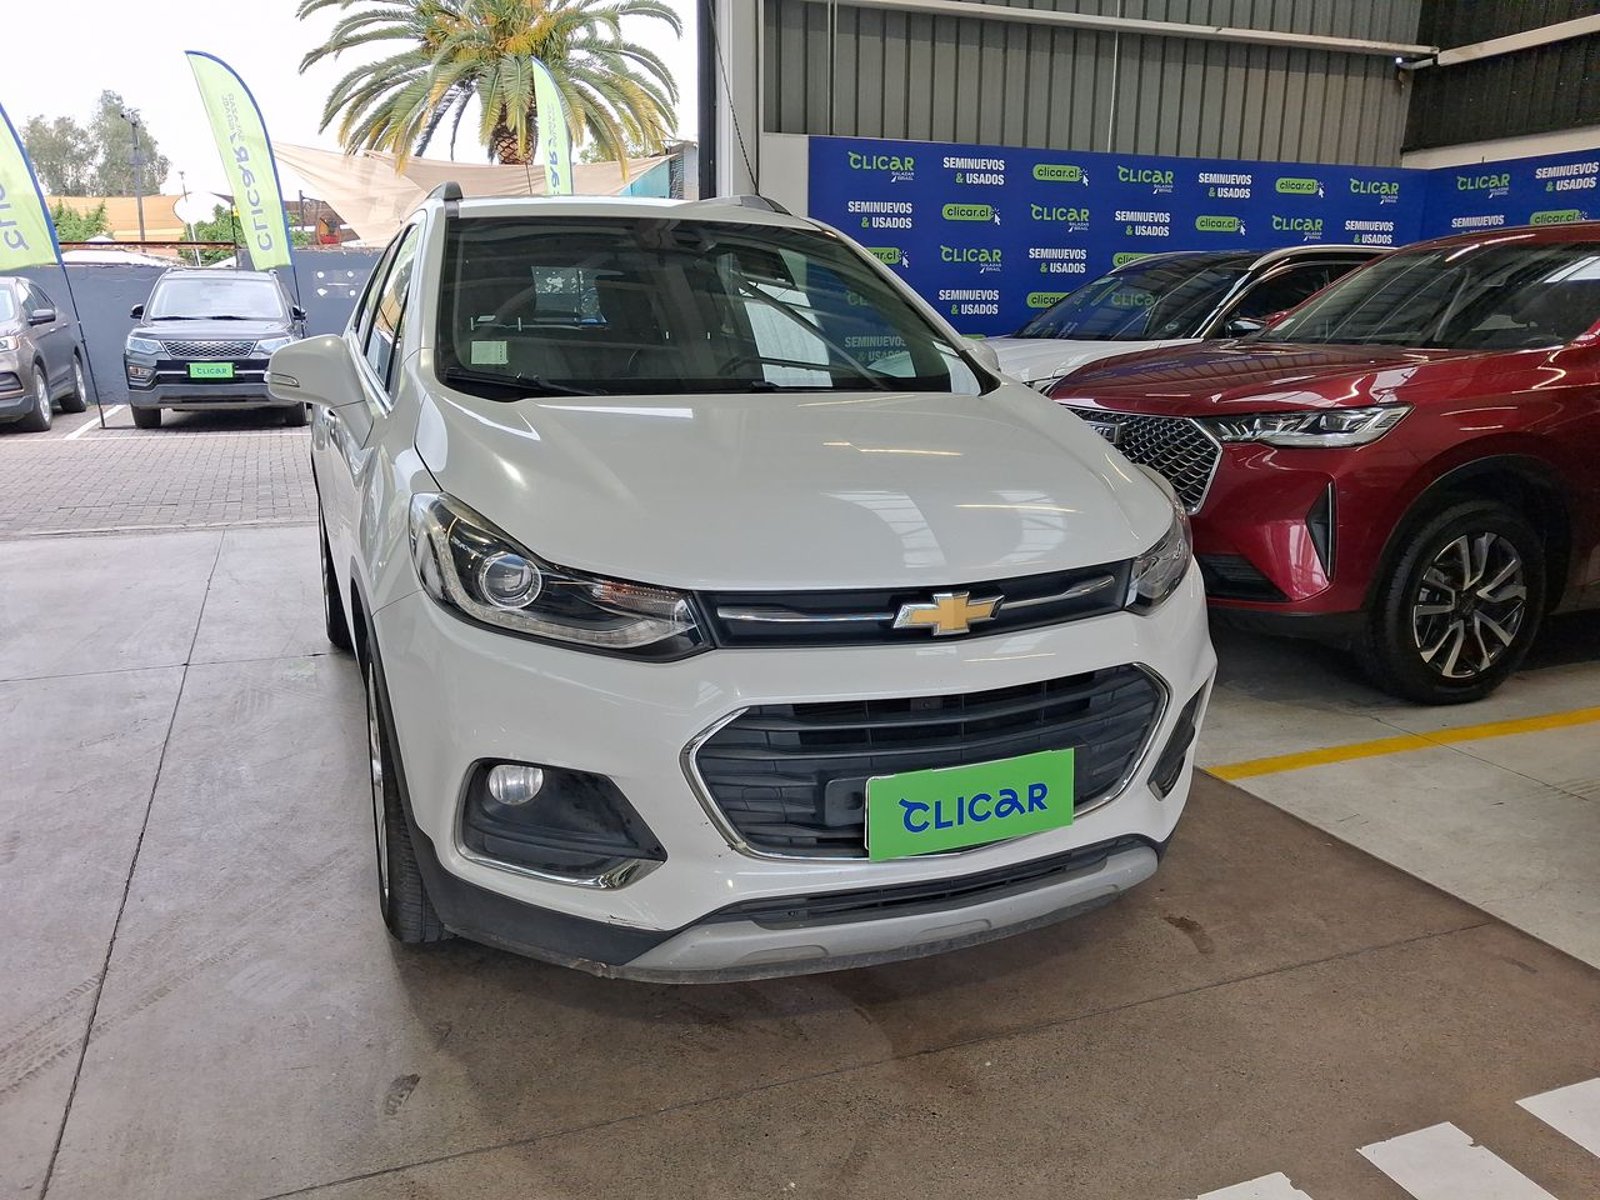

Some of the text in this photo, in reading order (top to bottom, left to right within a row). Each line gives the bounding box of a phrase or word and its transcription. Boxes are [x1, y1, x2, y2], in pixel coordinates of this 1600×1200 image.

[943, 157, 1005, 170] SEMINUEVOS
[1037, 167, 1077, 179] clicar.cl
[1535, 161, 1600, 179] SEMINUEVOS
[956, 172, 1005, 185] & USADOS
[1199, 172, 1252, 185] SEMINUEVOS
[1546, 177, 1597, 192] & USADOS
[1279, 179, 1315, 191] clicar.cl
[1208, 187, 1251, 199] & USADOS
[848, 201, 912, 214] SEMINUEVOS
[947, 206, 989, 218] clicar.cl
[1115, 210, 1171, 223] SEMINUEVOS
[1451, 215, 1505, 228] SEMINUEVOS
[861, 217, 912, 229] & USADOS
[1199, 217, 1236, 229] clicar.cl
[1345, 220, 1394, 232] SEMINUEVOS
[1126, 225, 1170, 237] & USADOS
[1353, 234, 1393, 245] & USADOS
[872, 249, 897, 261] ar.cl
[1029, 247, 1087, 260] SEMINUEVOS
[1040, 262, 1086, 274] & USADOS
[939, 289, 999, 301] SEMINUEVOS
[1111, 291, 1155, 306] CLICA
[951, 304, 998, 315] & USADOS
